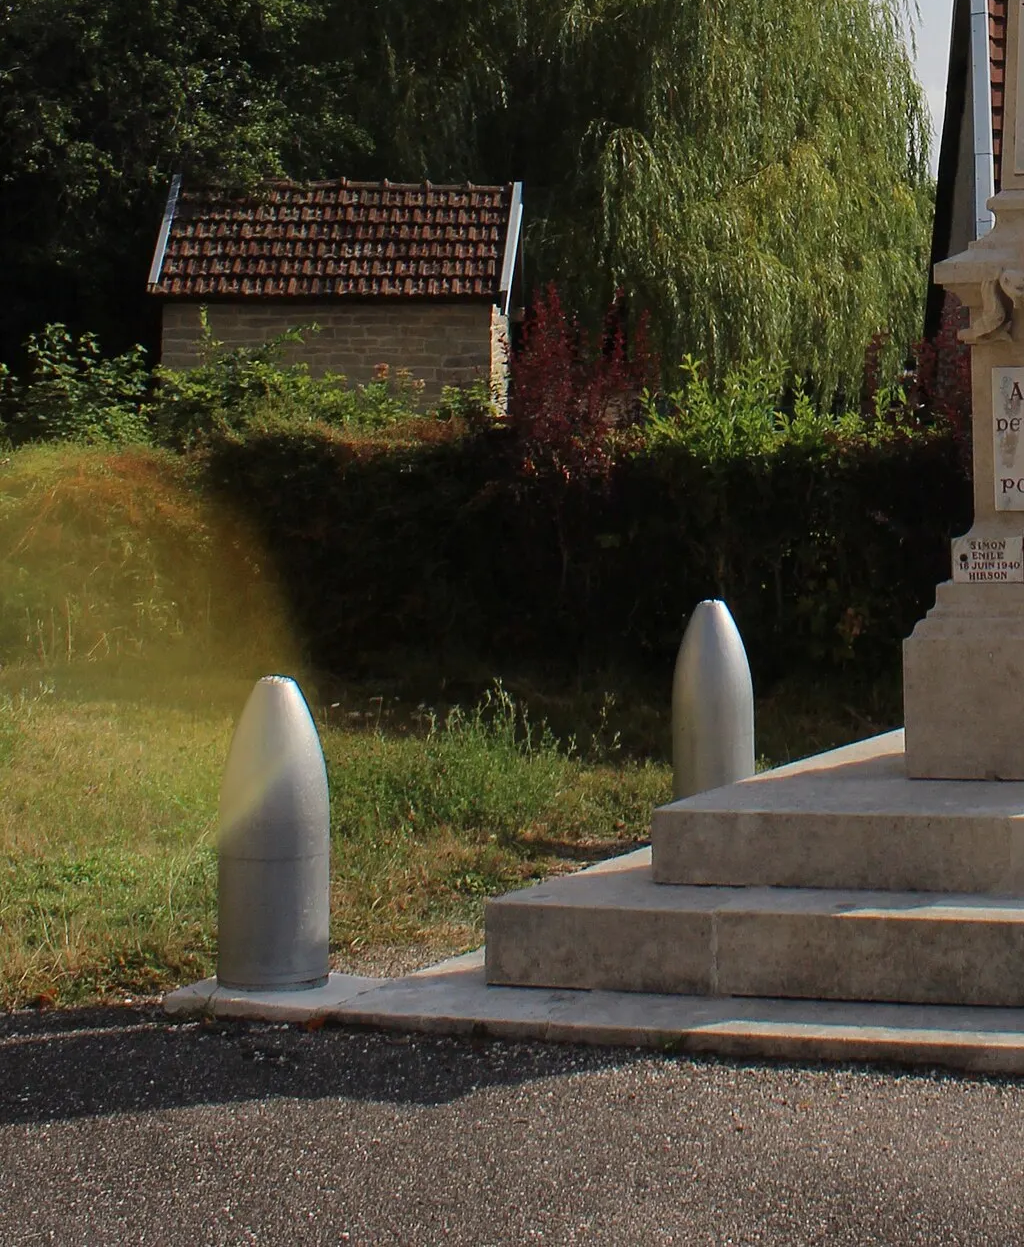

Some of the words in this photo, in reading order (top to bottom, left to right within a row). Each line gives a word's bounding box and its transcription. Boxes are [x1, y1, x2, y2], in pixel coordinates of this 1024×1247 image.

[970, 542, 1006, 550] SIMON
[972, 562, 994, 570] JUIN
[997, 562, 1020, 570] 1940
[969, 571, 1007, 580] HIRSON
